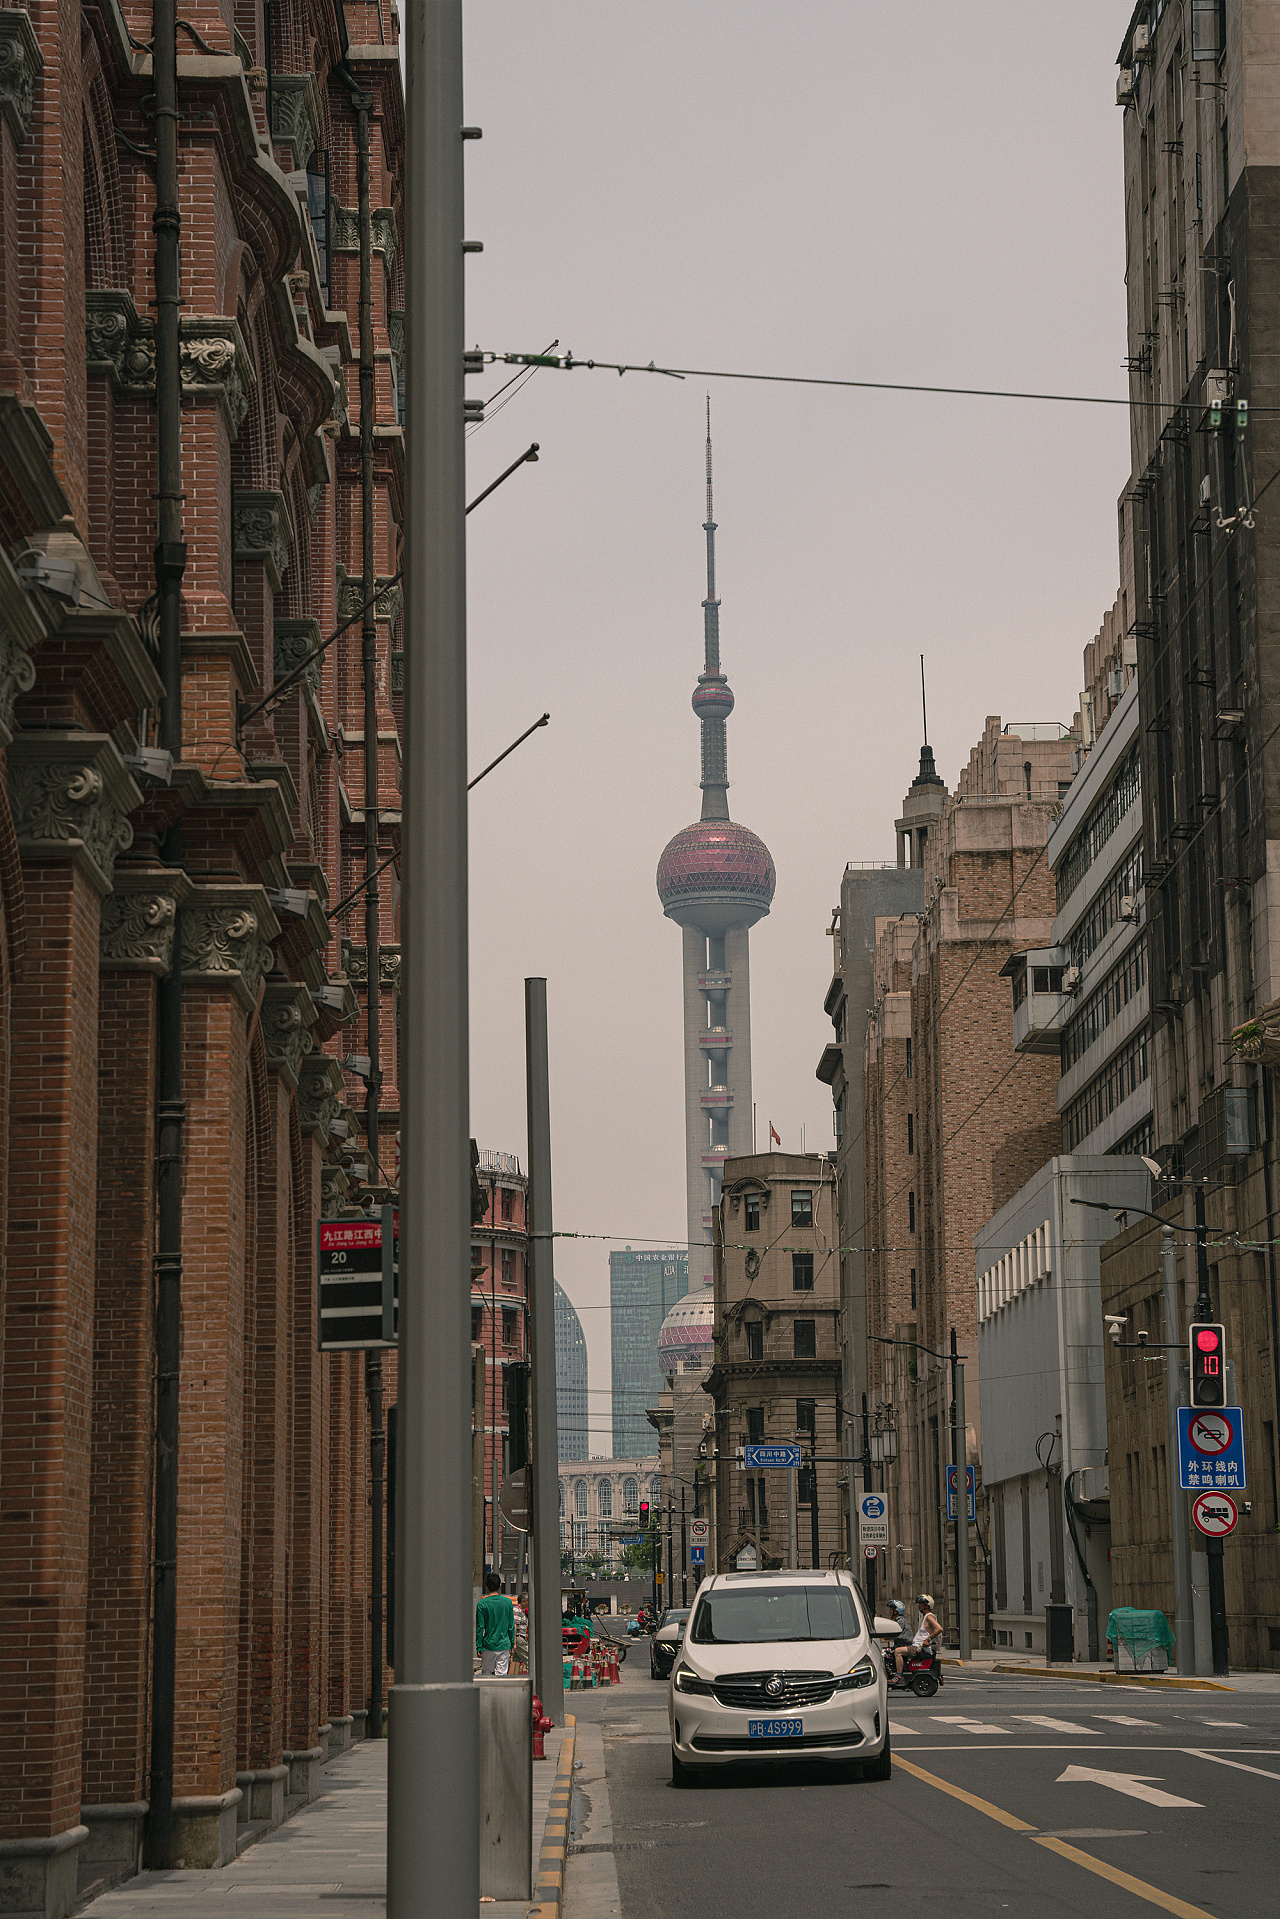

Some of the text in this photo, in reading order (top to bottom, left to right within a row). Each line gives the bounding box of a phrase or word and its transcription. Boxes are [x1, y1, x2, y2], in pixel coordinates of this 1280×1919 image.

[331, 1251, 347, 1264] 20
[636, 1254, 682, 1262] 中国农业银行
[1203, 1356, 1219, 1375] 10
[1188, 1460, 1238, 1473] 外环线内
[1188, 1474, 1239, 1486] 禁鸣喇叭
